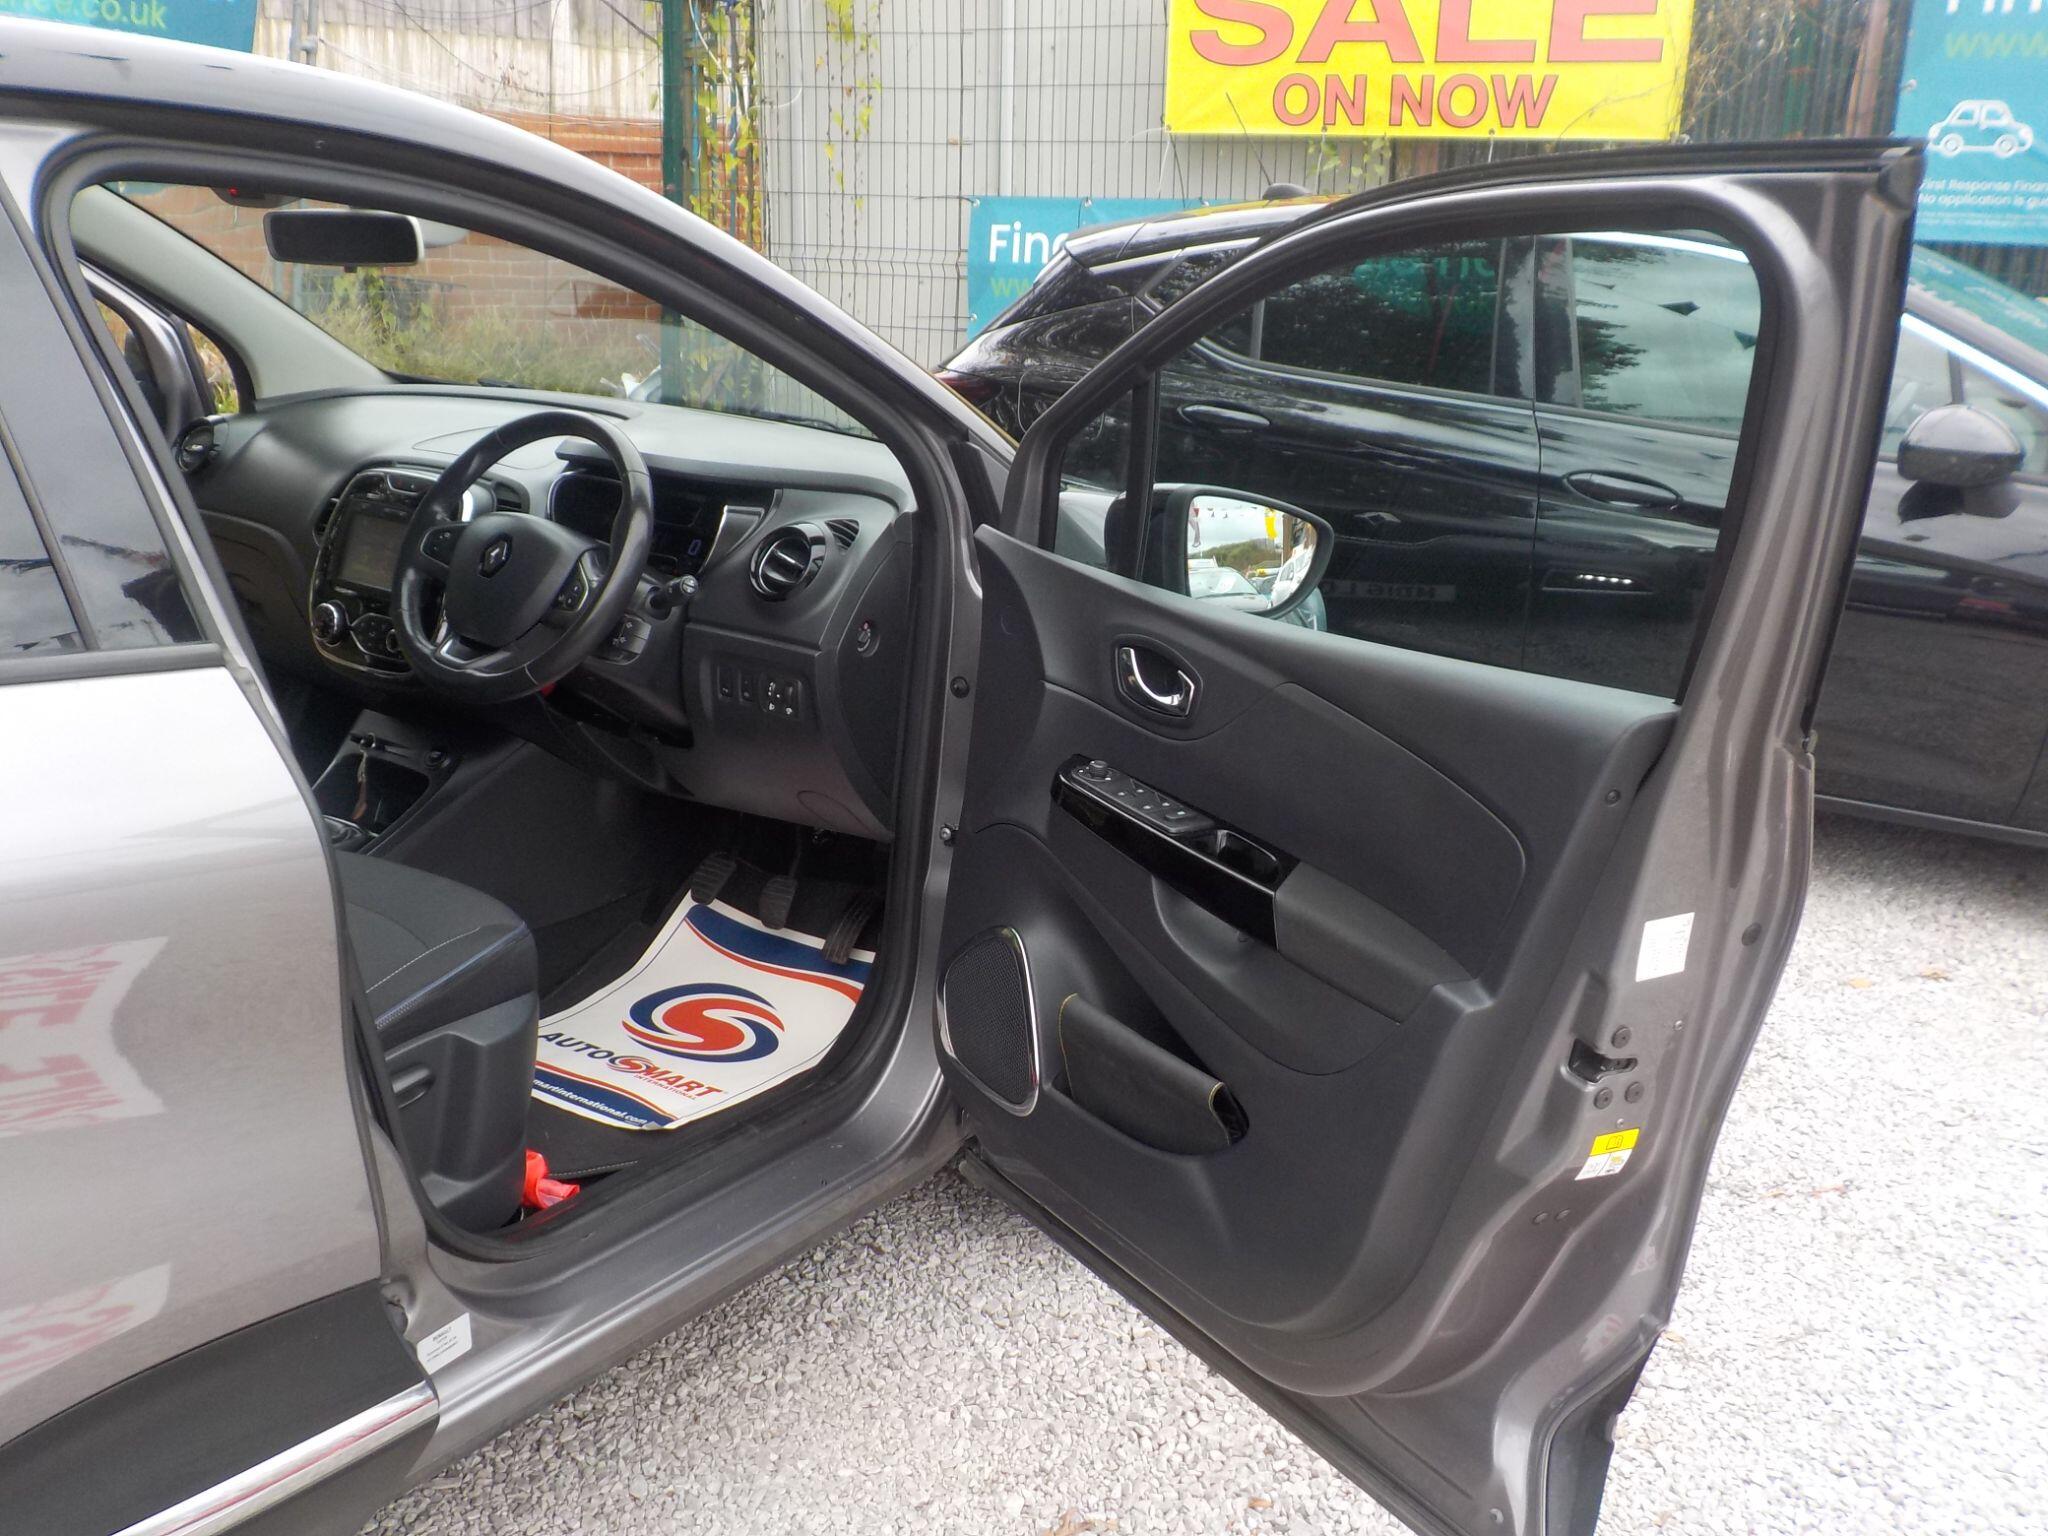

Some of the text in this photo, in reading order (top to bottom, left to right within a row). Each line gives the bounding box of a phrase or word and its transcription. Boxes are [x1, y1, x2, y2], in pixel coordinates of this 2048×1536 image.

[1189, 0, 1664, 67] SALE
[1272, 72, 1559, 129] ON NOW
[633, 1073, 698, 1101] INTERNATIONAL
